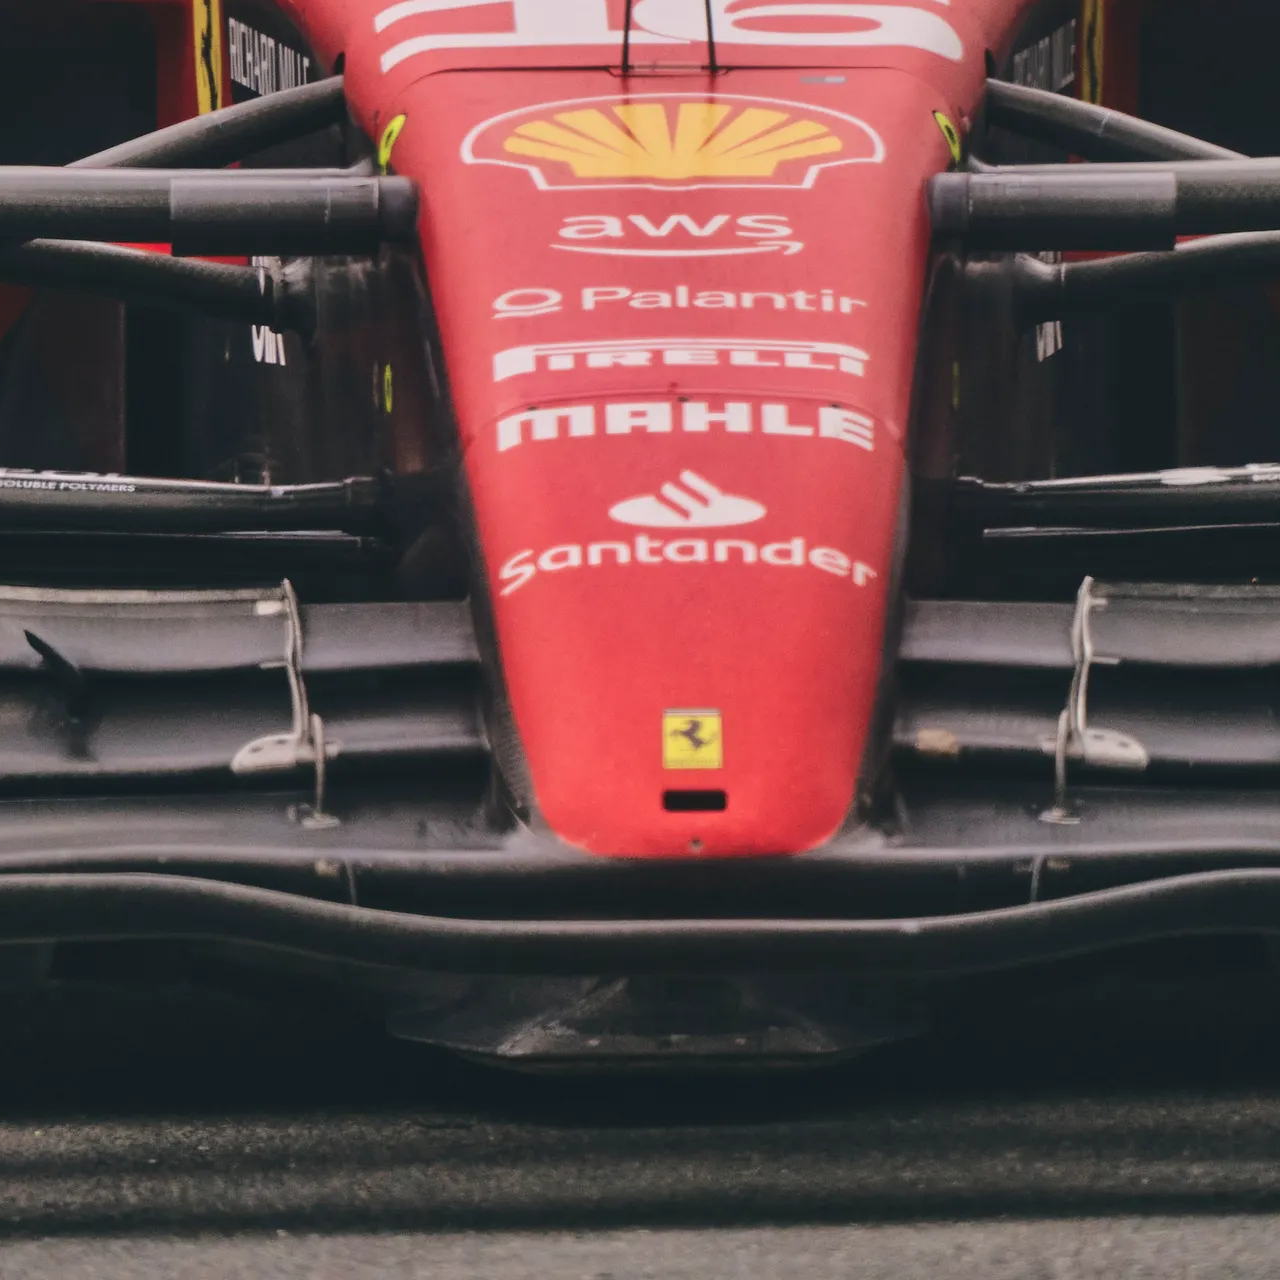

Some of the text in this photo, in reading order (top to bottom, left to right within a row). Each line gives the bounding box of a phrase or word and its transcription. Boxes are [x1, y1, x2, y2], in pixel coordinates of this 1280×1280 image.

[557, 212, 794, 240] aws
[580, 284, 869, 317] Palantir
[492, 336, 871, 382] PIRELLI
[496, 401, 875, 453] MAHLE
[59, 481, 136, 493] POLYMERS
[499, 535, 878, 597] Santander
